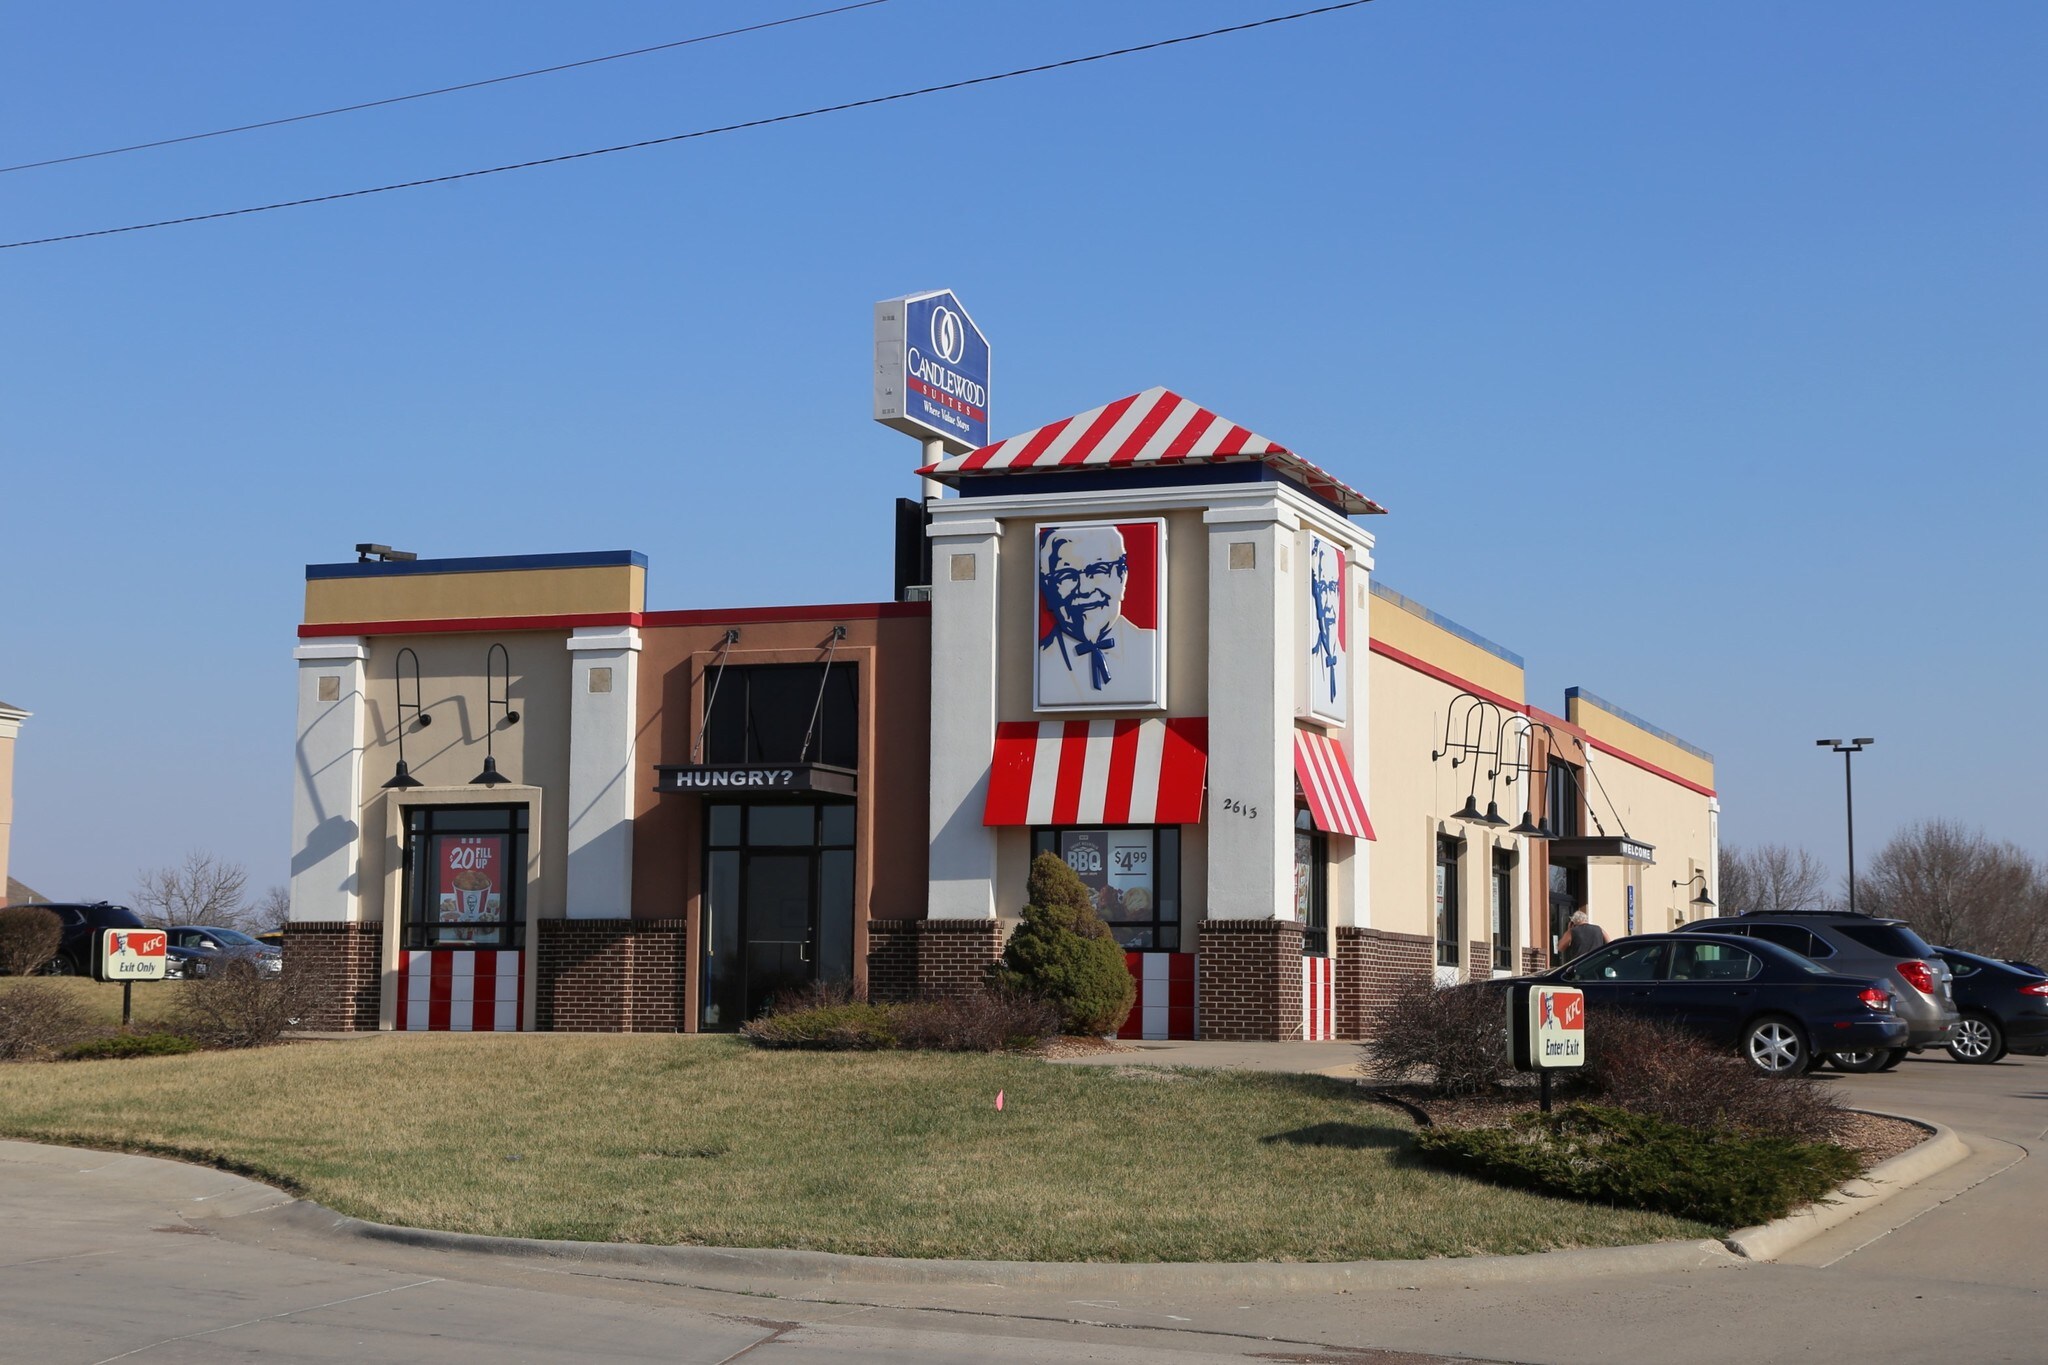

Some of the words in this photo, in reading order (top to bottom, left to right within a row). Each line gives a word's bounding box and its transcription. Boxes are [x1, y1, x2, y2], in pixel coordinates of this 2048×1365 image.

[908, 347, 985, 408] CANDLEWOOD
[922, 385, 971, 416] SUITES
[923, 400, 940, 418] Where
[676, 770, 793, 787] HUNGRY?
[475, 848, 491, 858] FILL
[1622, 843, 1651, 860] WELCOME
[475, 859, 488, 869] UP
[1067, 851, 1103, 872] BBQ
[142, 936, 163, 953] KFC
[119, 962, 135, 972] Exit
[136, 962, 155, 974] Only
[1565, 997, 1581, 1025] KFC
